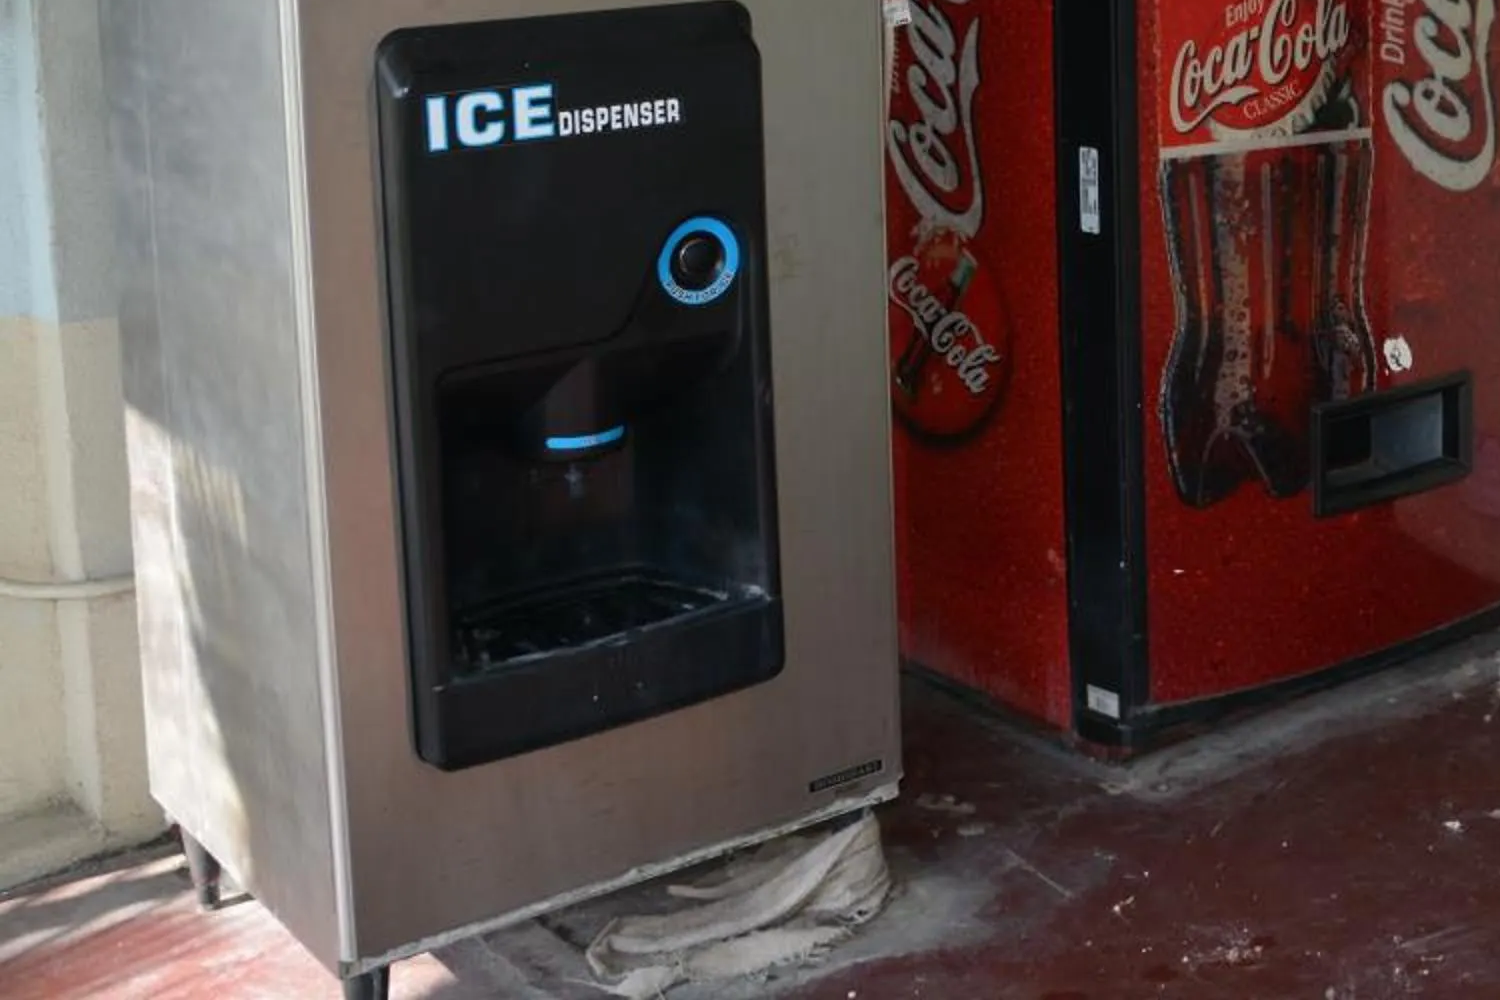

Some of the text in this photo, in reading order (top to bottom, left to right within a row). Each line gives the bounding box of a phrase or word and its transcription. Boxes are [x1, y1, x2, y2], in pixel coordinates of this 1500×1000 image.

[426, 83, 681, 153] ICE DISPENSER
[1243, 80, 1302, 120] CLASSIC
[889, 256, 1001, 393] Coca-Cola
